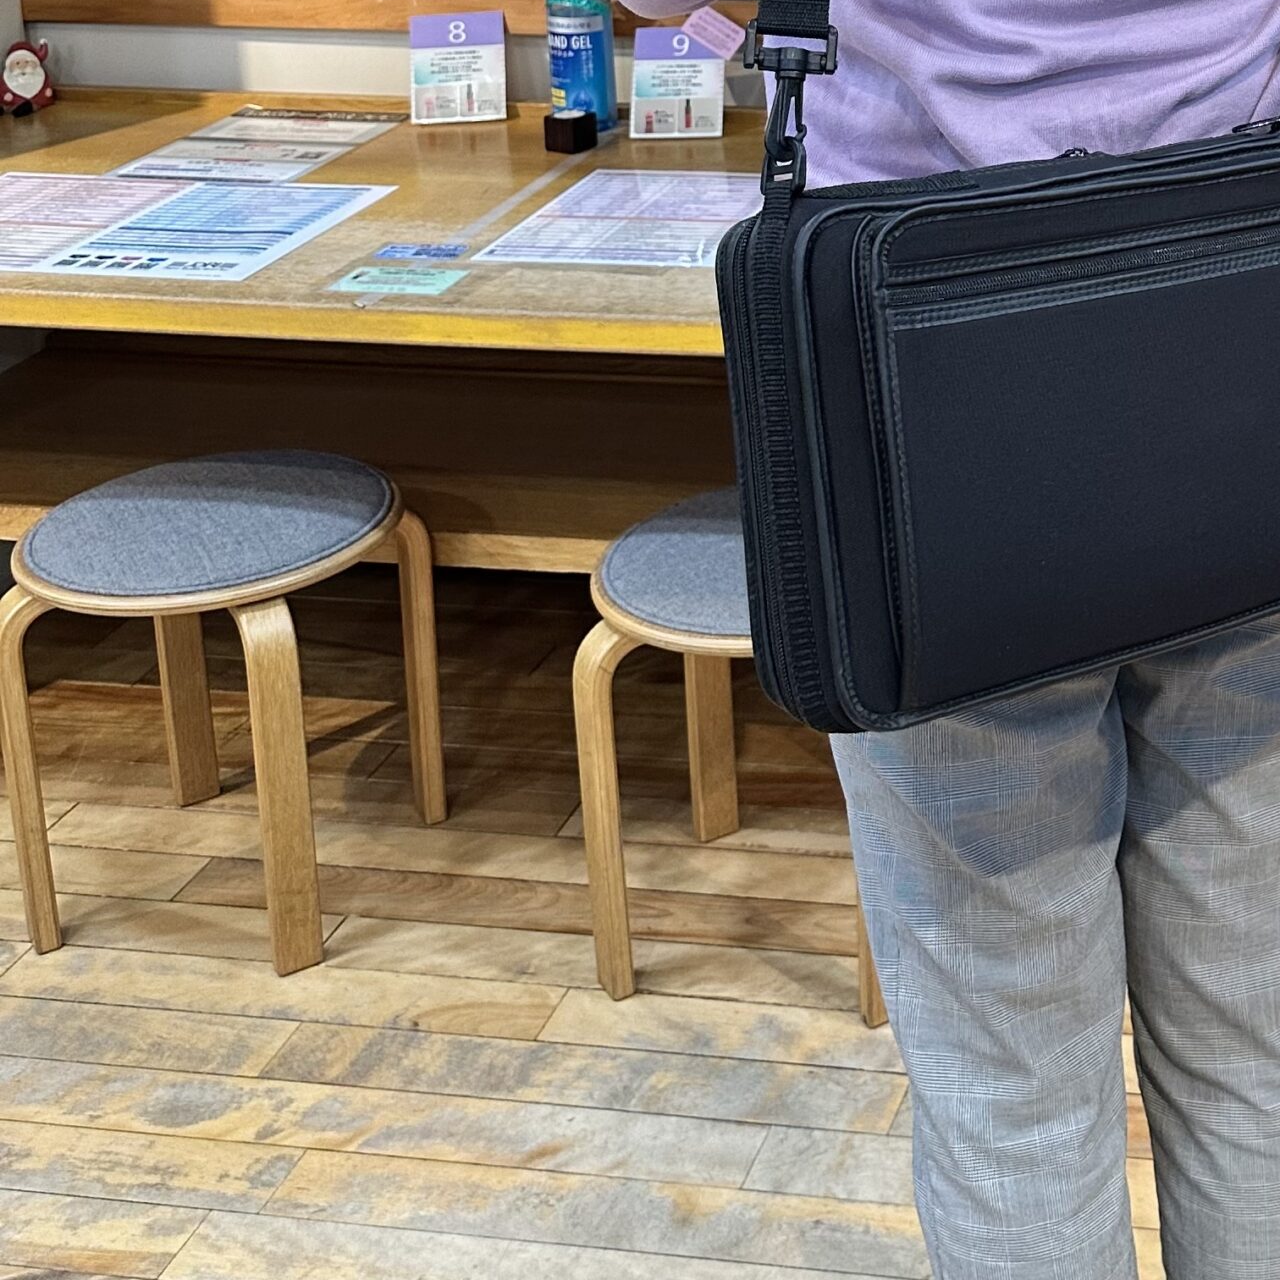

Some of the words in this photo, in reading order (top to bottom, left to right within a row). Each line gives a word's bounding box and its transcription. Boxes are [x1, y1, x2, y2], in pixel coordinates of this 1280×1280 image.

[448, 21, 467, 43] 8
[571, 34, 592, 49] GEL
[672, 34, 690, 56] 9
